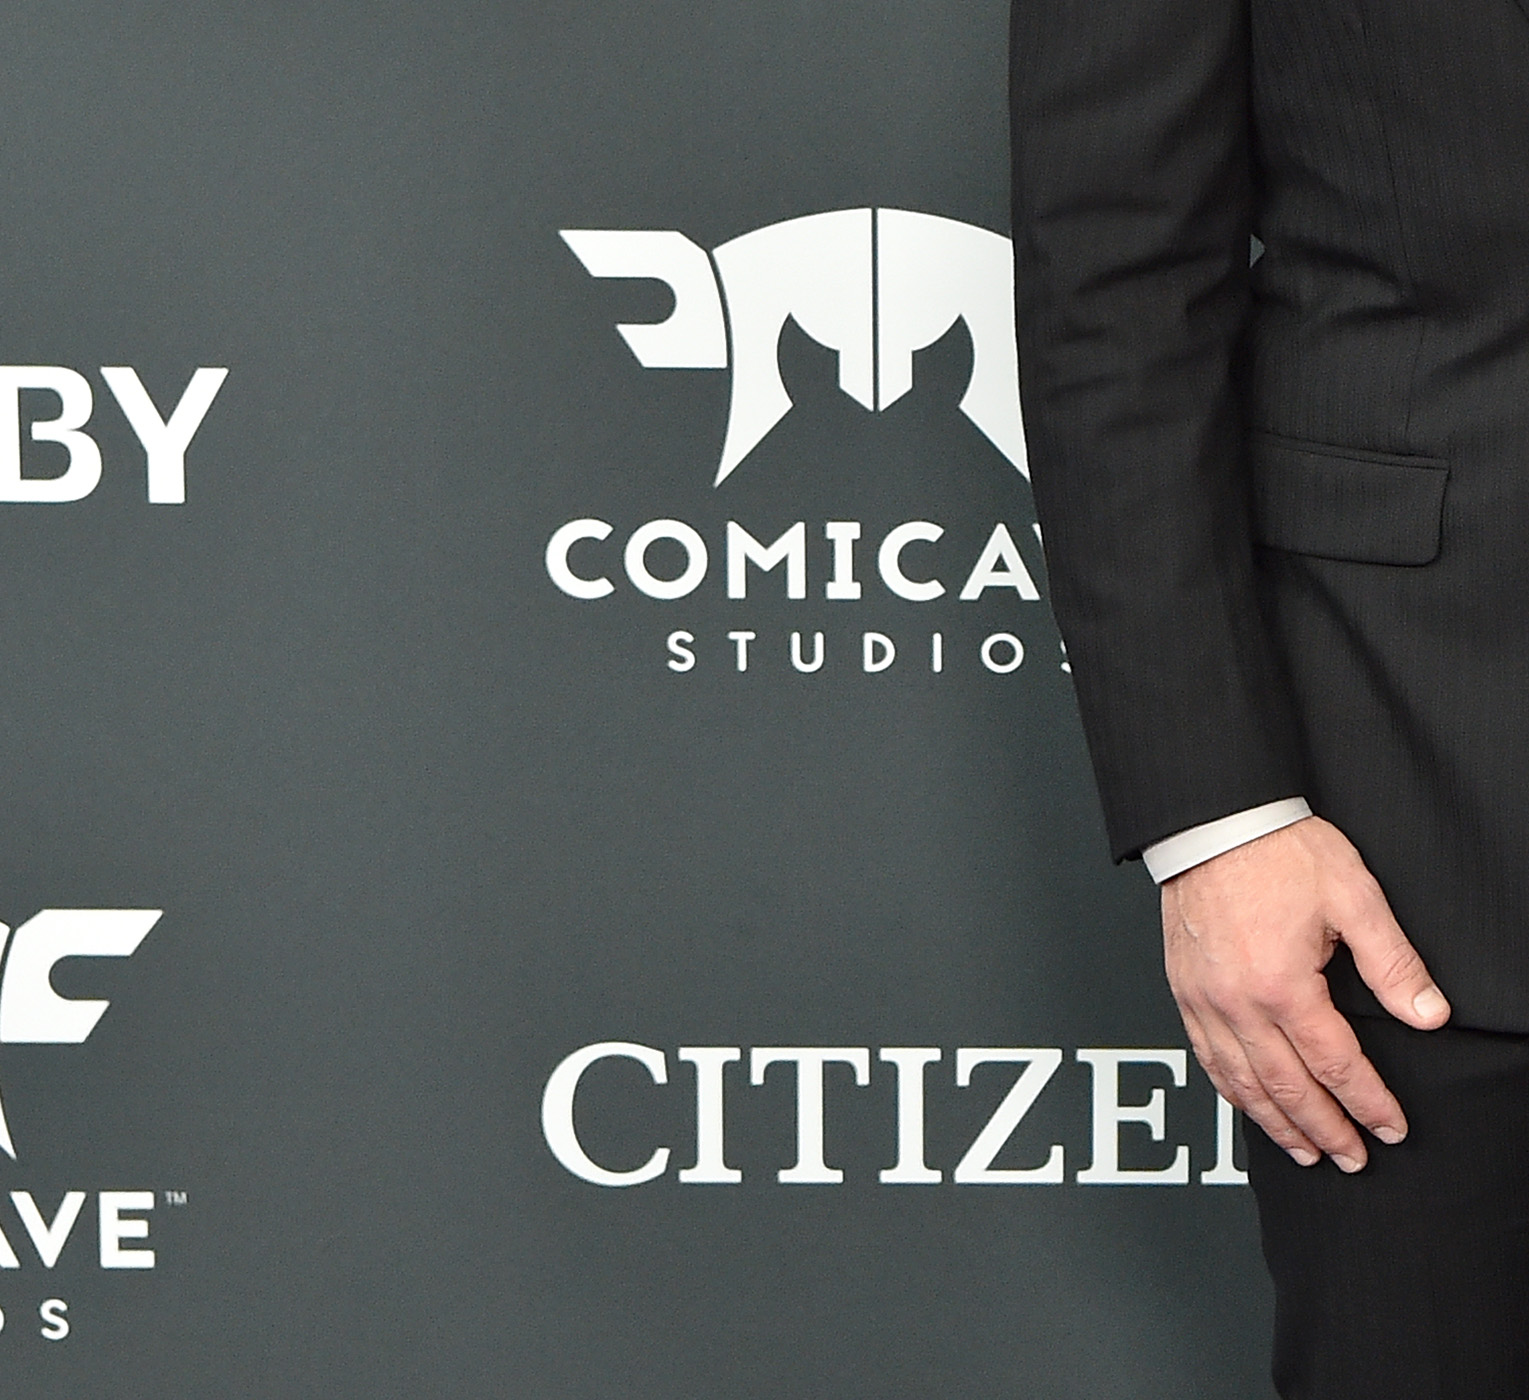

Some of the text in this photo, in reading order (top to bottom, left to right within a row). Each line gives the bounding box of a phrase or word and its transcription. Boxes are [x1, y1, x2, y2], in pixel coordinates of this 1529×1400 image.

[0, 366, 229, 504] BY
[546, 519, 1043, 601] COMICA
[667, 631, 1072, 674] STUDIO
[0, 1299, 69, 1340] S
